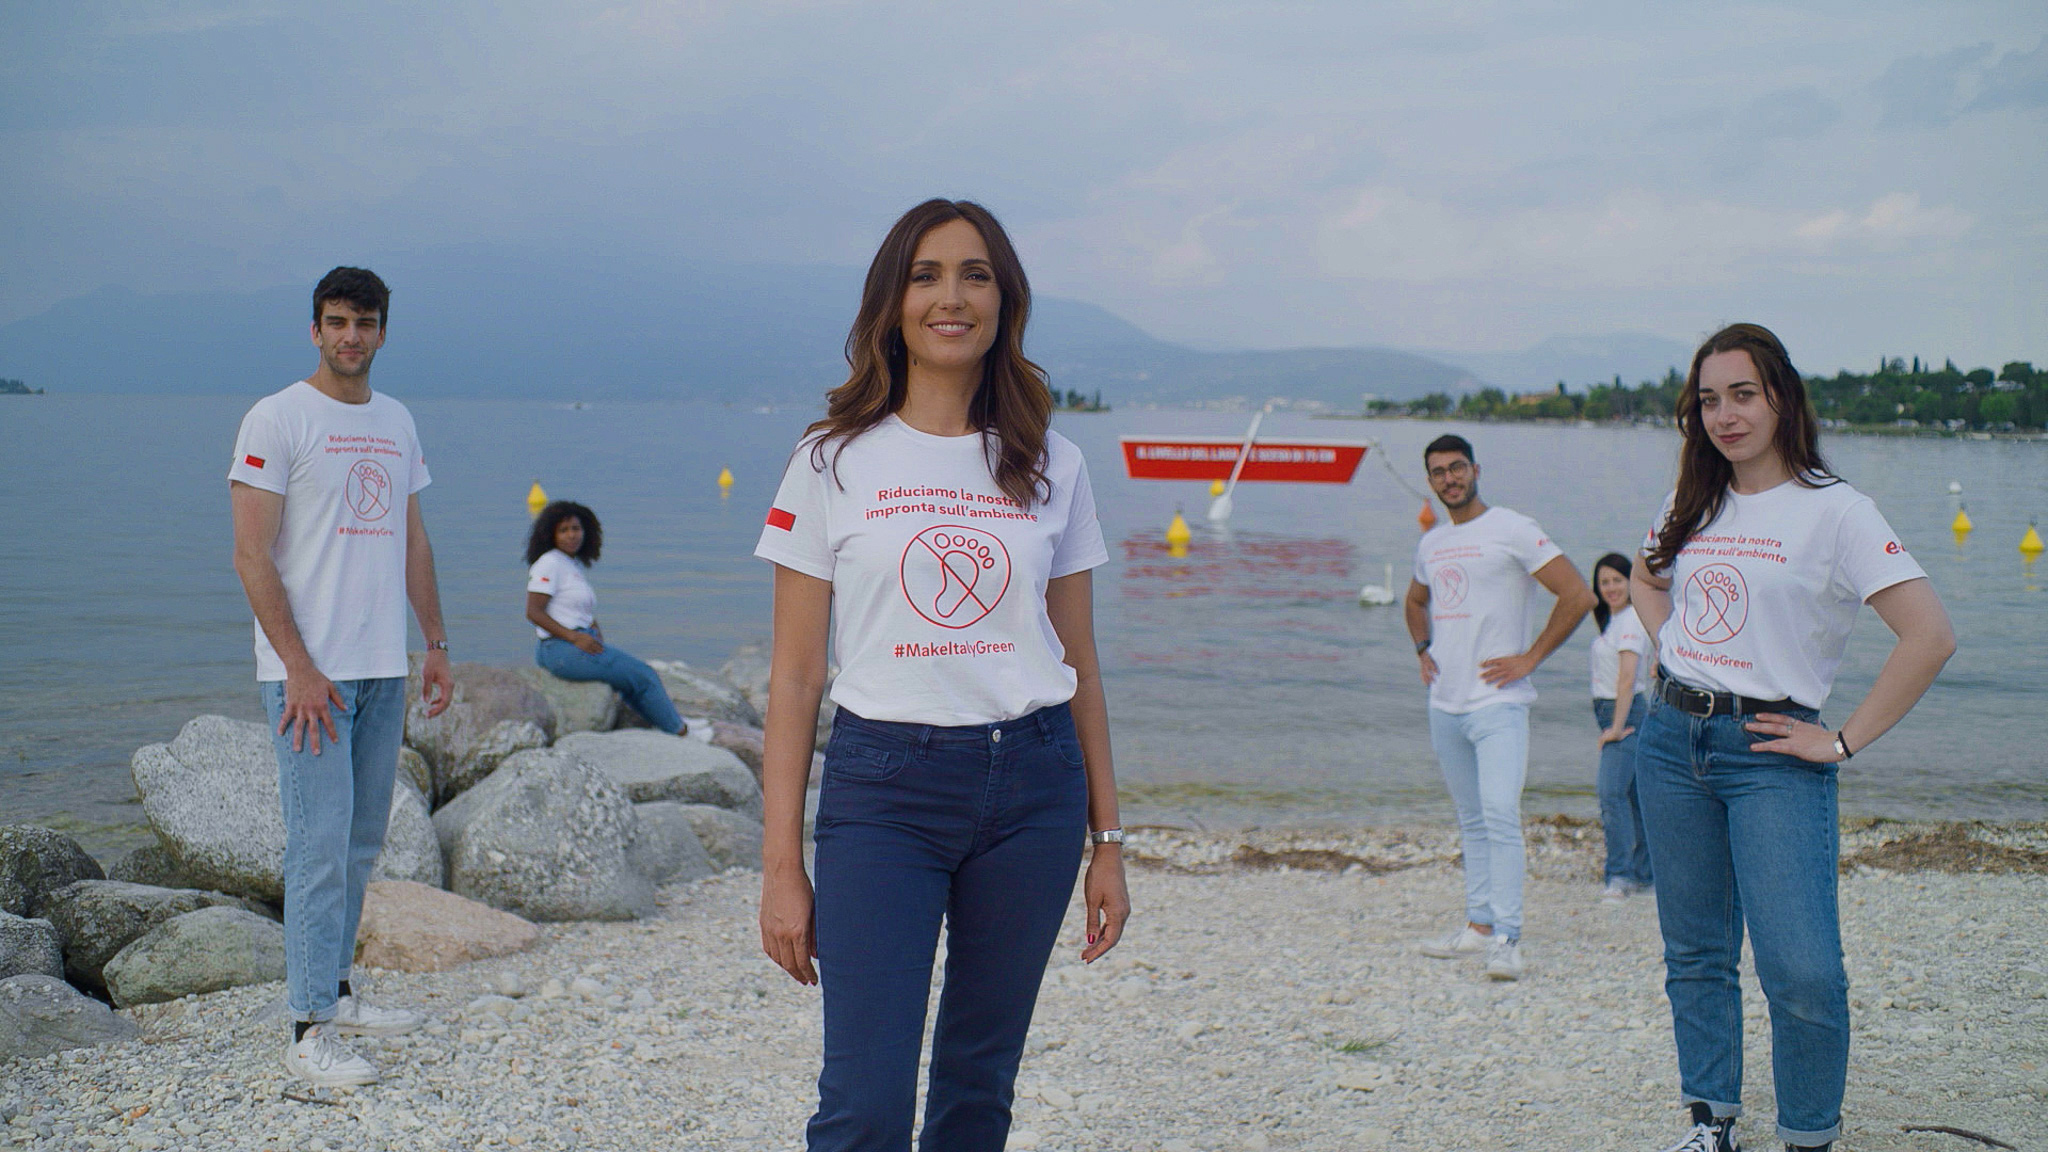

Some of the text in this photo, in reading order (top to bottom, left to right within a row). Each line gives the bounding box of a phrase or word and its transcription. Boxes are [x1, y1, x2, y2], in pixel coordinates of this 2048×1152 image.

[878, 484, 1024, 510] Riduciamo la nostra
[865, 502, 1038, 523] impronta sull'ambiente
[1737, 534, 1747, 545] la
[1748, 537, 1783, 549] nostra
[1716, 547, 1788, 565] sull'ambiente
[894, 640, 1016, 658] #MakeItalyGreen
